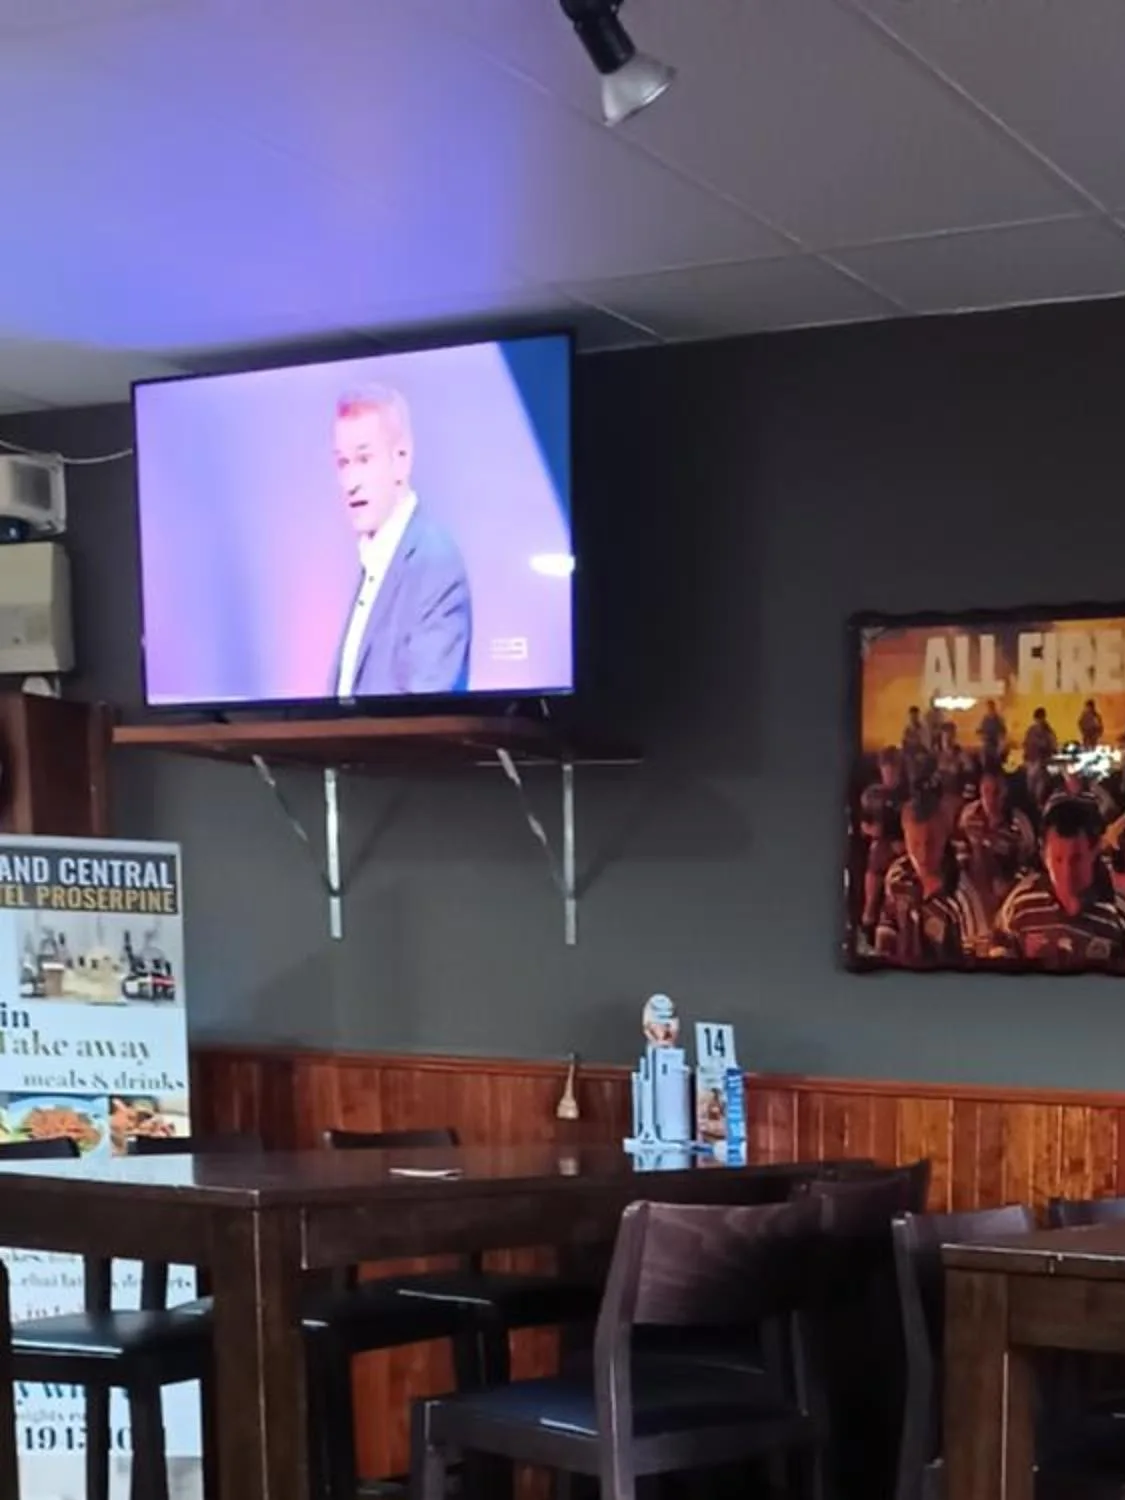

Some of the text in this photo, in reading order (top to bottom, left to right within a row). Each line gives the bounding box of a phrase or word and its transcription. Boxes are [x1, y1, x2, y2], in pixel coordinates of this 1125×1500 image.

[923, 633, 1006, 698] ALL
[59, 857, 175, 889] CENTRAL
[36, 885, 175, 912] PROSERPINE
[76, 1039, 151, 1066] away
[703, 1027, 726, 1058] 14
[24, 1069, 87, 1088] meals
[113, 1071, 186, 1090] drinks
